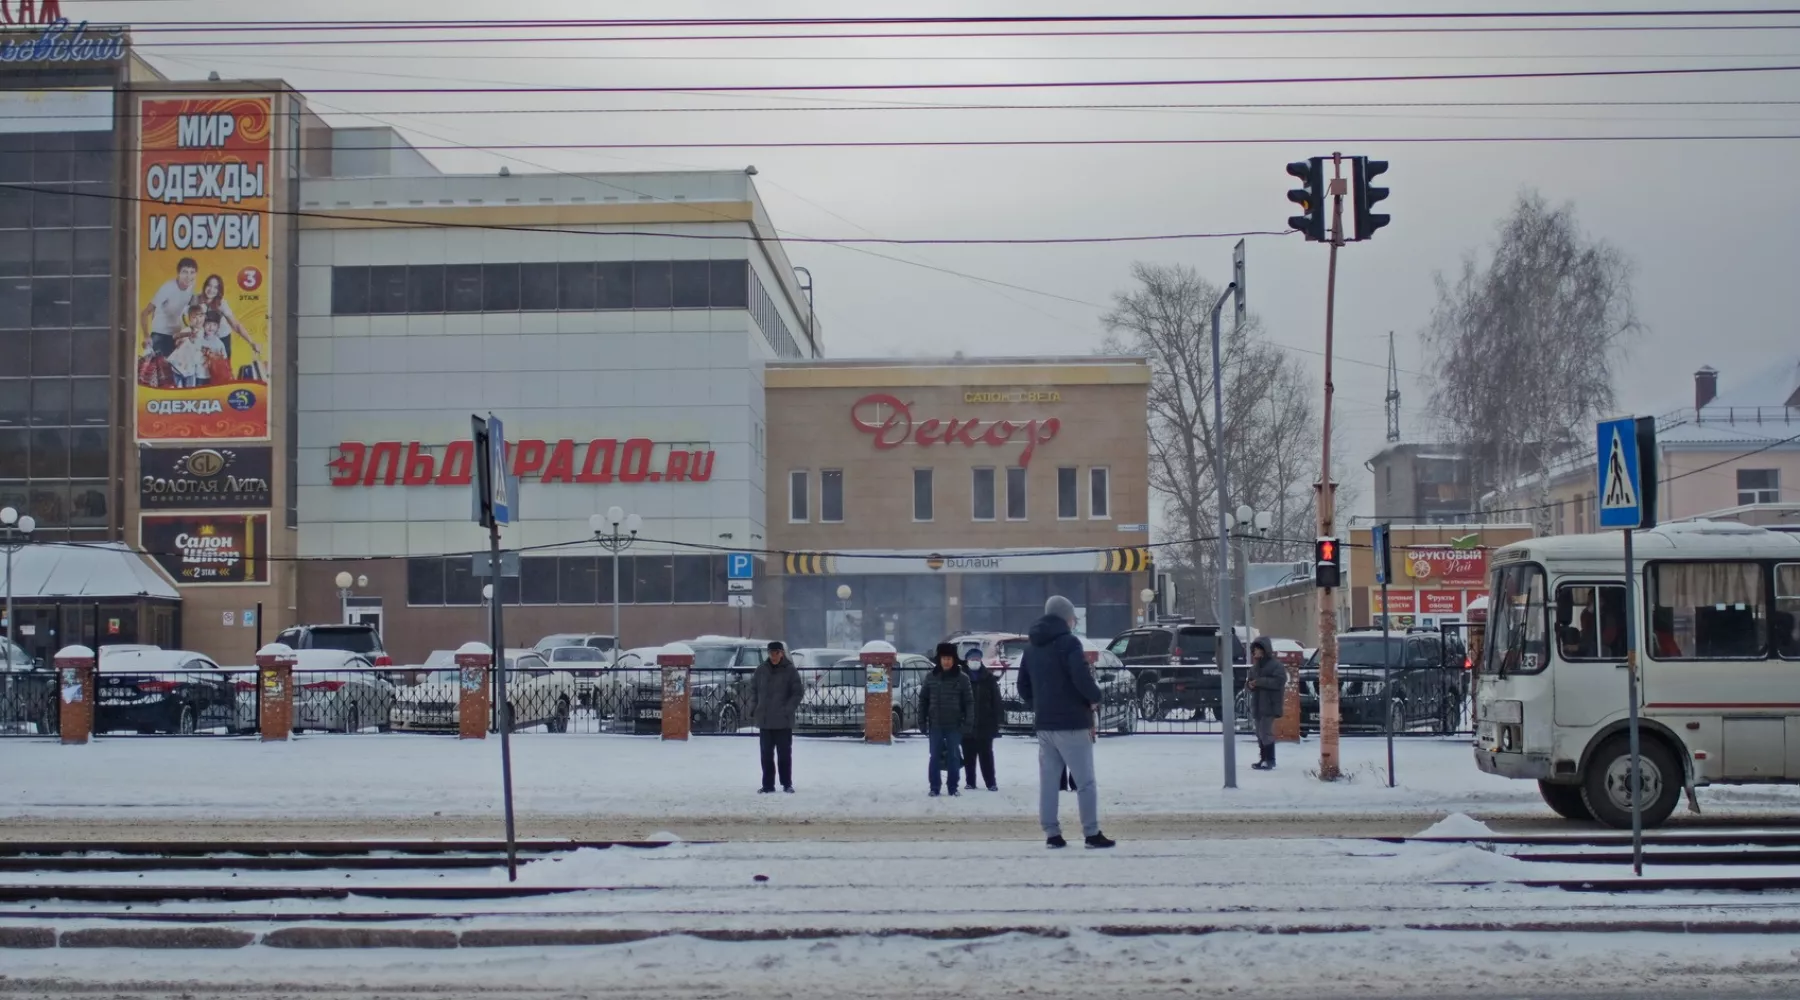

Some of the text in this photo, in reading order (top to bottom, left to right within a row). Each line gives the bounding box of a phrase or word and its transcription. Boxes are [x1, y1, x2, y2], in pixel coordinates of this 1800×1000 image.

[178, 113, 235, 148] МИР
[146, 162, 264, 204] ОДЕЖДЫ
[148, 213, 261, 250] И ОБУВИ
[243, 270, 257, 287] 3
[147, 400, 222, 415] ОДЕЖДА
[851, 393, 1061, 468] Декор
[191, 455, 217, 473] GL
[325, 438, 716, 487] ЭЛЬДРАДО.RU
[175, 533, 232, 549] Салон
[1408, 550, 1482, 560] ФРУКТОВЫЙ
[193, 567, 217, 578] 2 ЭТАЖ
[735, 556, 748, 575] P
[1443, 560, 1473, 575] Рай
[1522, 655, 1537, 668] 23
